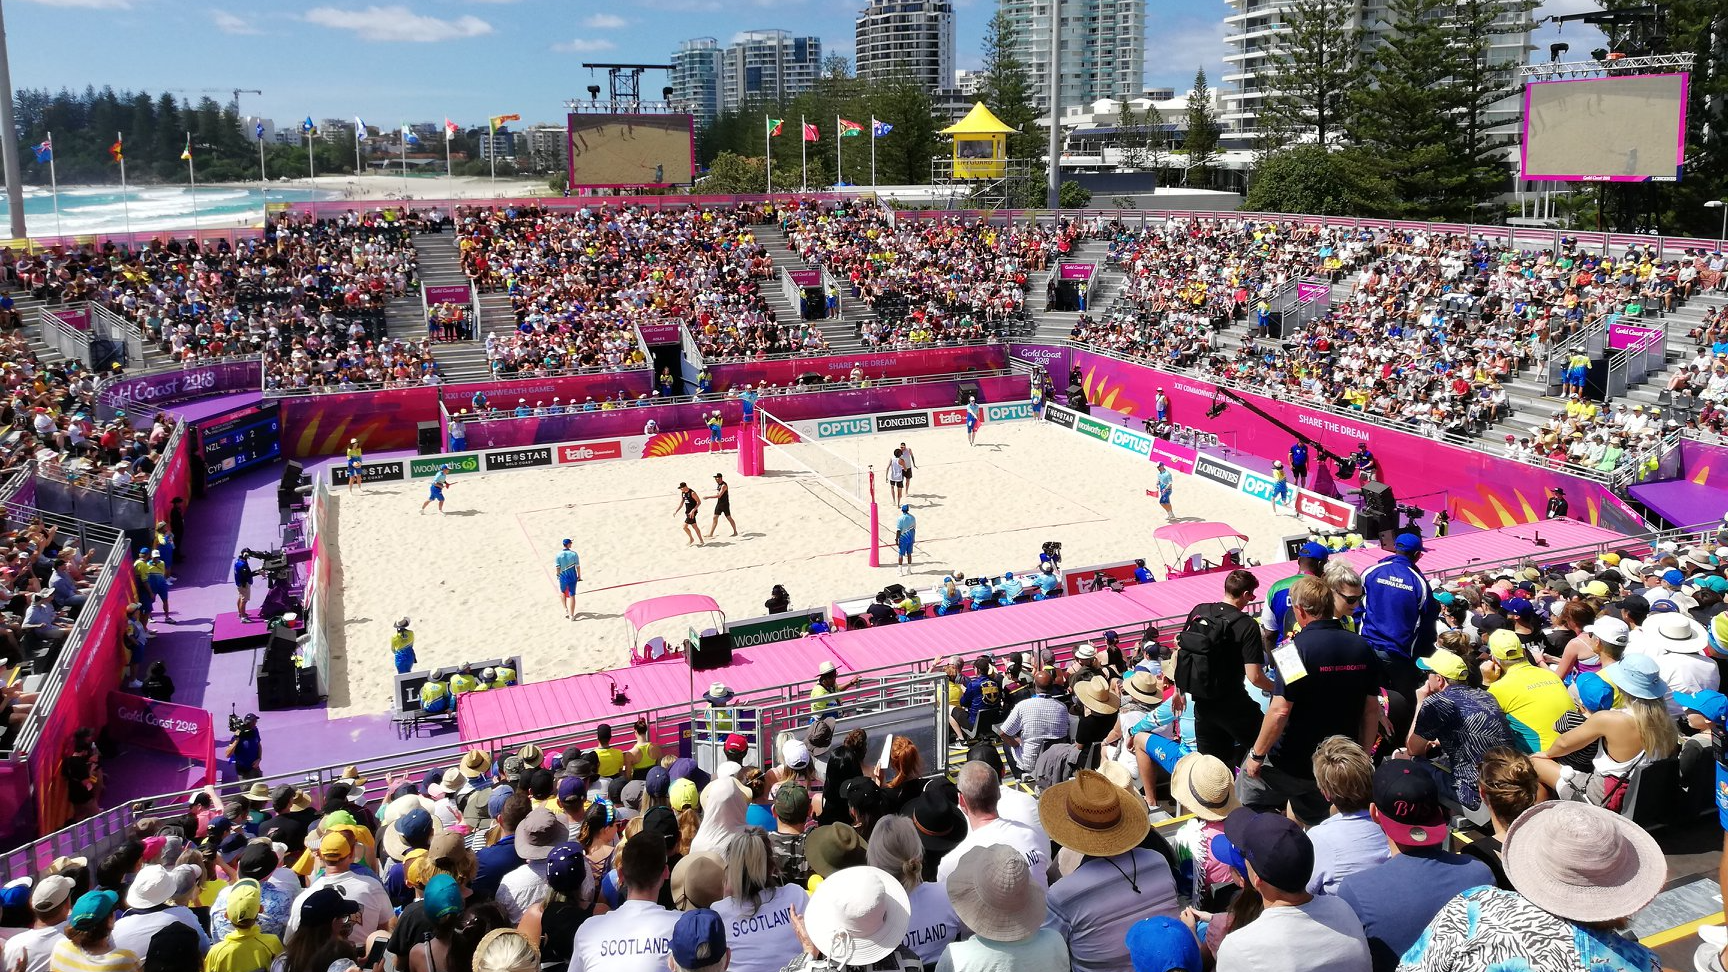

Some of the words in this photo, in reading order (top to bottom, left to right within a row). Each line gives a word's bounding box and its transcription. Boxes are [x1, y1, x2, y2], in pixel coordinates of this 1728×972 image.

[1021, 348, 1040, 357] Gold
[1041, 350, 1062, 359] Coast
[828, 361, 853, 370] SHARE
[854, 360, 870, 368] HE
[870, 358, 897, 367] DREAM
[135, 378, 179, 401] Coast
[182, 371, 215, 392] 2018
[528, 385, 555, 394] GAMES
[878, 416, 927, 428] LONGINES
[939, 412, 962, 424] tafe
[819, 419, 870, 436] OPTUS
[1298, 414, 1323, 429] SHARE
[1323, 421, 1339, 433] THE
[1340, 426, 1370, 441] DREAM
[205, 442, 221, 453] NZL
[235, 434, 244, 443] 16
[250, 430, 255, 438] 2
[1115, 431, 1150, 453] OPTUS
[490, 454, 512, 464] THE
[519, 451, 548, 460] STAR
[564, 446, 594, 460] tafe
[207, 463, 222, 474] CYP
[237, 454, 246, 464] 21
[252, 451, 257, 459] 1
[336, 469, 359, 478] TH
[369, 465, 400, 475] STAR
[1197, 461, 1239, 484] LONGINES
[1301, 498, 1325, 518] tafe
[1390, 575, 1404, 584] TEAM
[1396, 582, 1414, 591] LEONE
[118, 706, 143, 723] Gold
[145, 712, 175, 729] Coast
[175, 718, 198, 735] 2018
[902, 923, 947, 948] OTLAND
[600, 937, 670, 957] SCOTLAND
